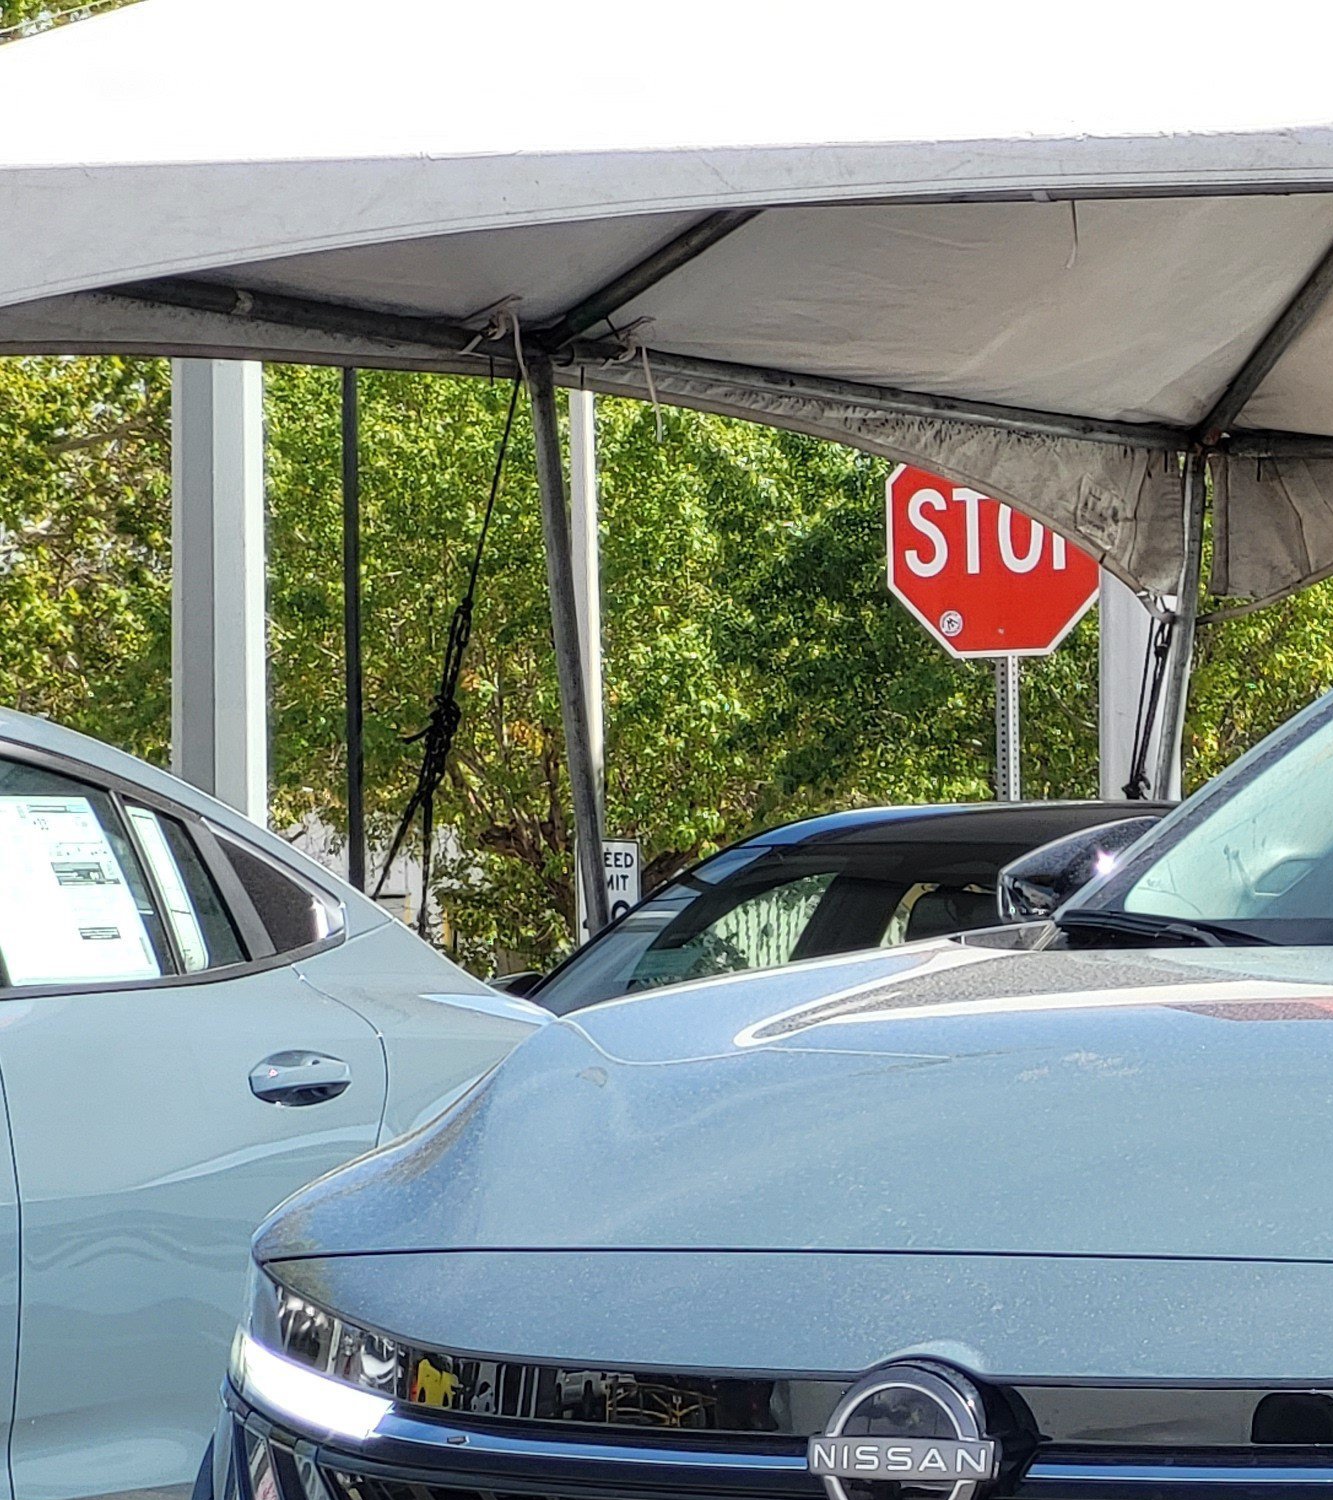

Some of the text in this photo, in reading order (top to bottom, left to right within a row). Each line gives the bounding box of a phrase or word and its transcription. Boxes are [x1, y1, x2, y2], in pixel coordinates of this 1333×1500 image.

[604, 852, 634, 868] EED
[607, 874, 629, 891] MIT
[813, 1443, 987, 1474] NISSAN
